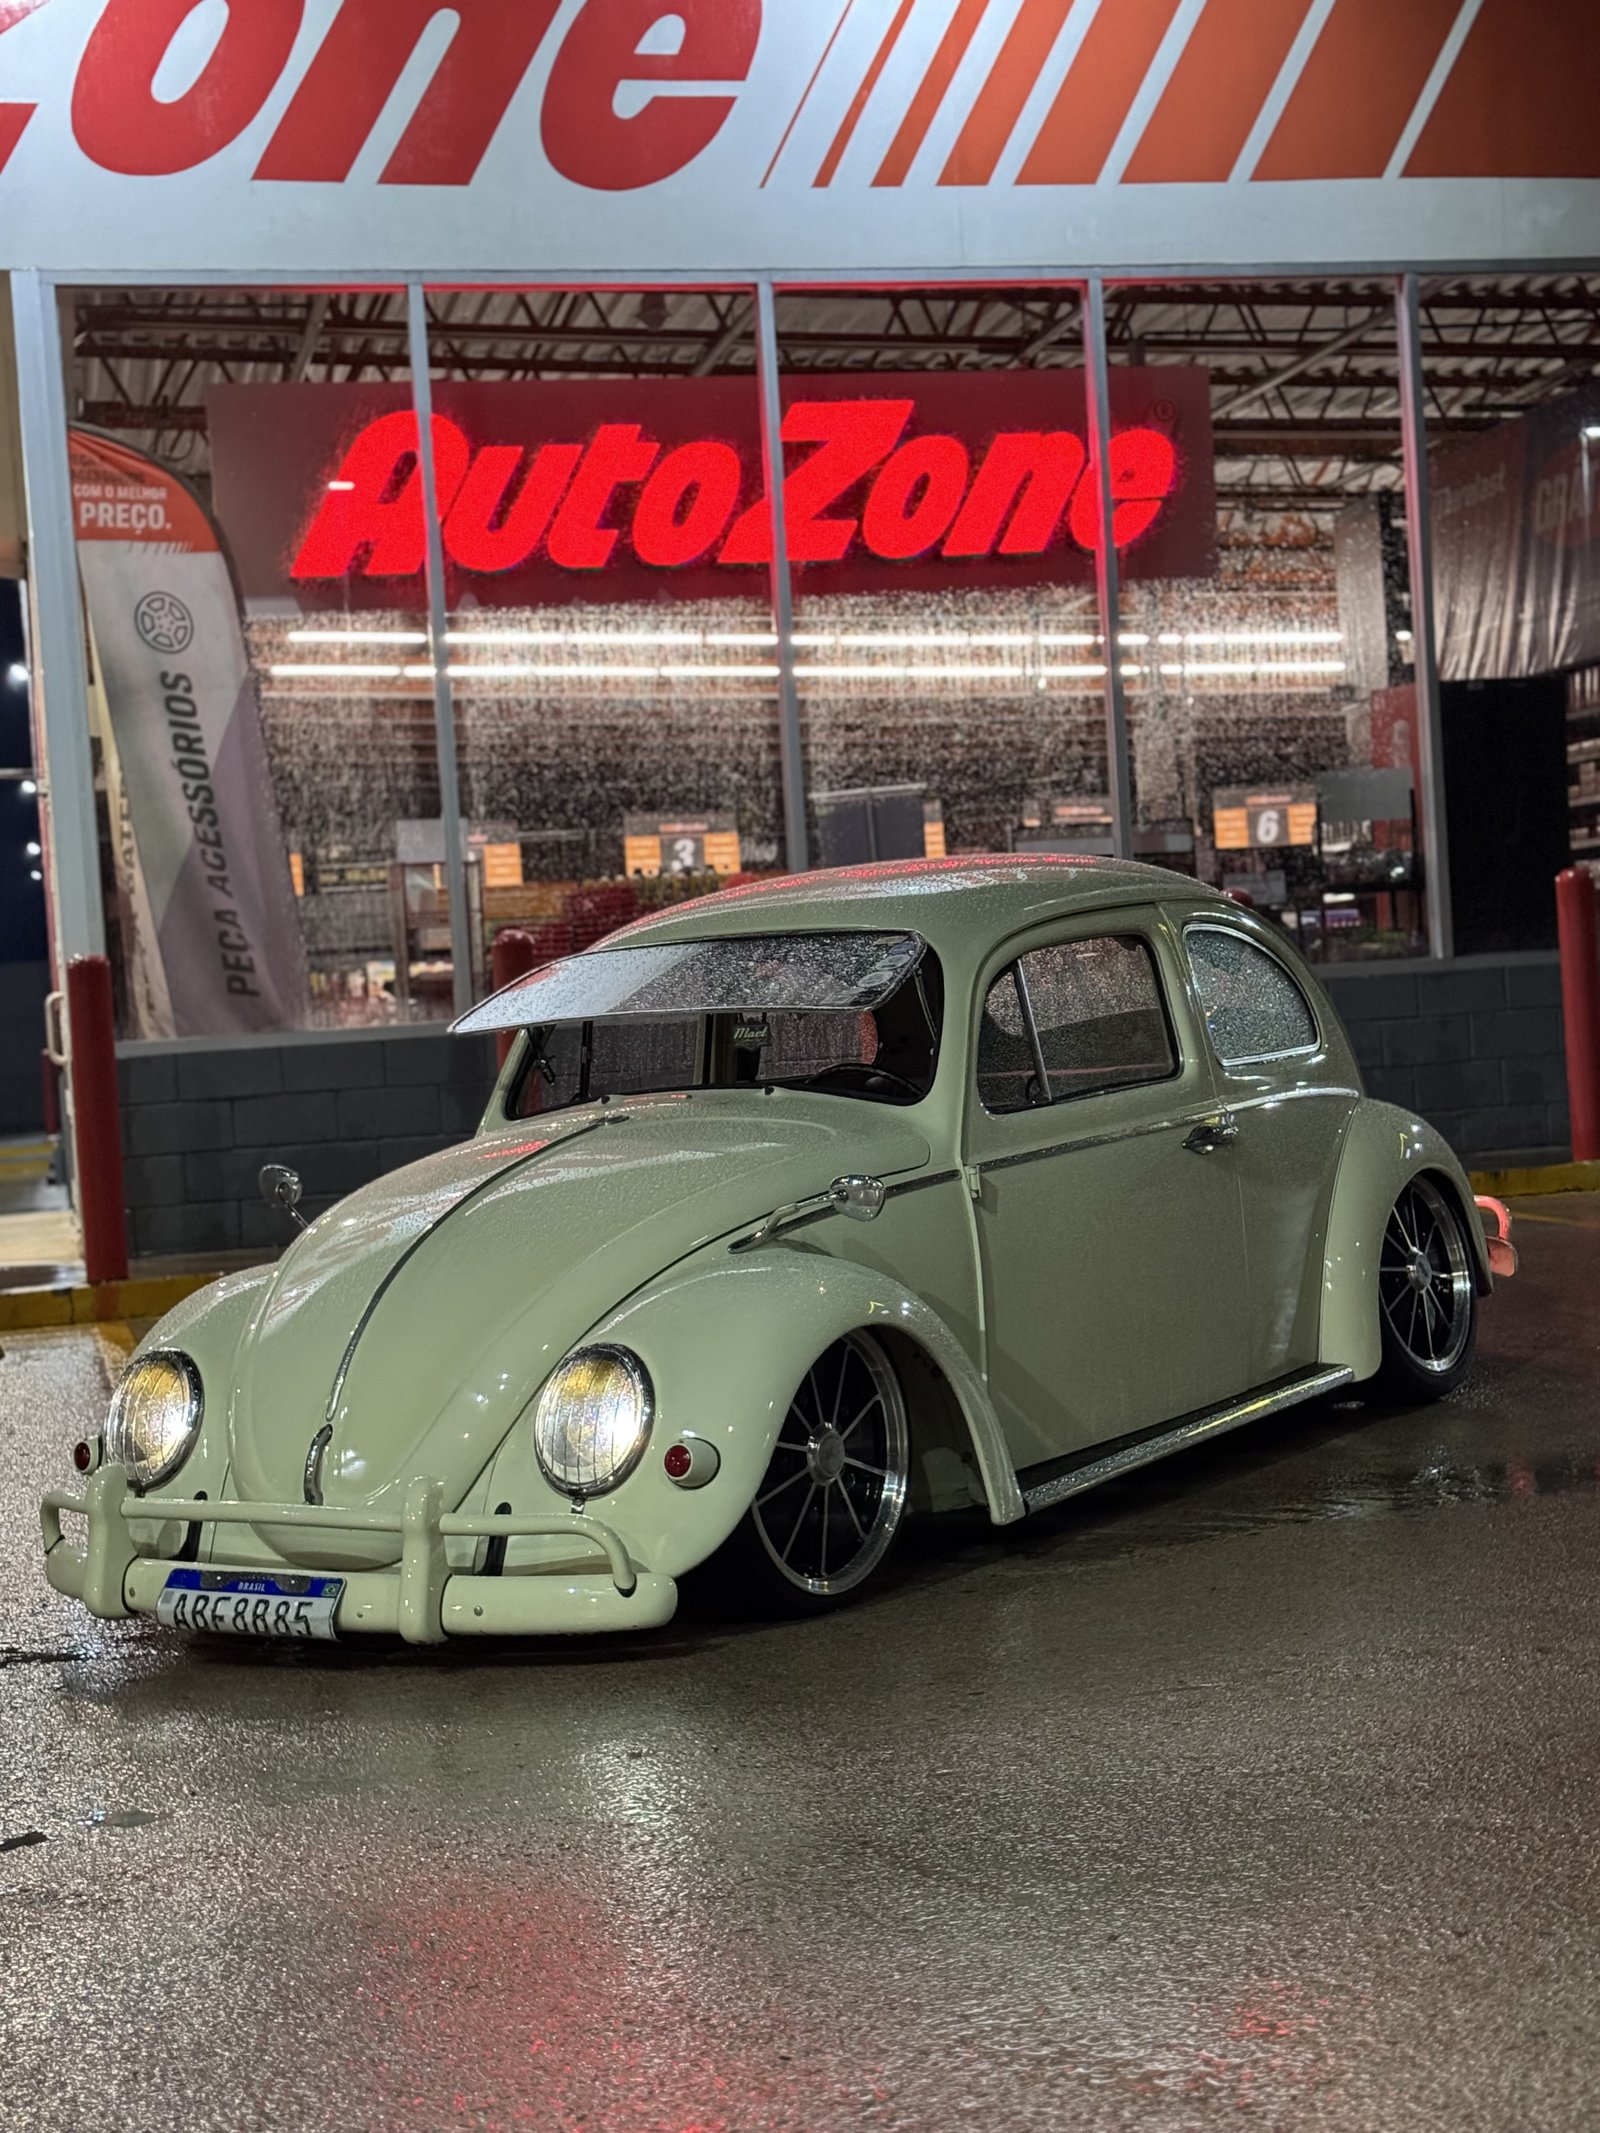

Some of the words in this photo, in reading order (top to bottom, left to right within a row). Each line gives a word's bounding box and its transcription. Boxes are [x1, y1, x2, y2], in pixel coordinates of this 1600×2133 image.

[73, 484, 102, 497] COM
[104, 485, 115, 498] O
[117, 486, 168, 499] MELHOR
[289, 399, 1175, 578] AutoZone
[80, 502, 172, 535] PREÇO.
[160, 671, 233, 898] ACESSÓRIOS
[1256, 810, 1280, 843] 6
[671, 838, 696, 872] 3
[237, 1581, 266, 1592] BRASIL
